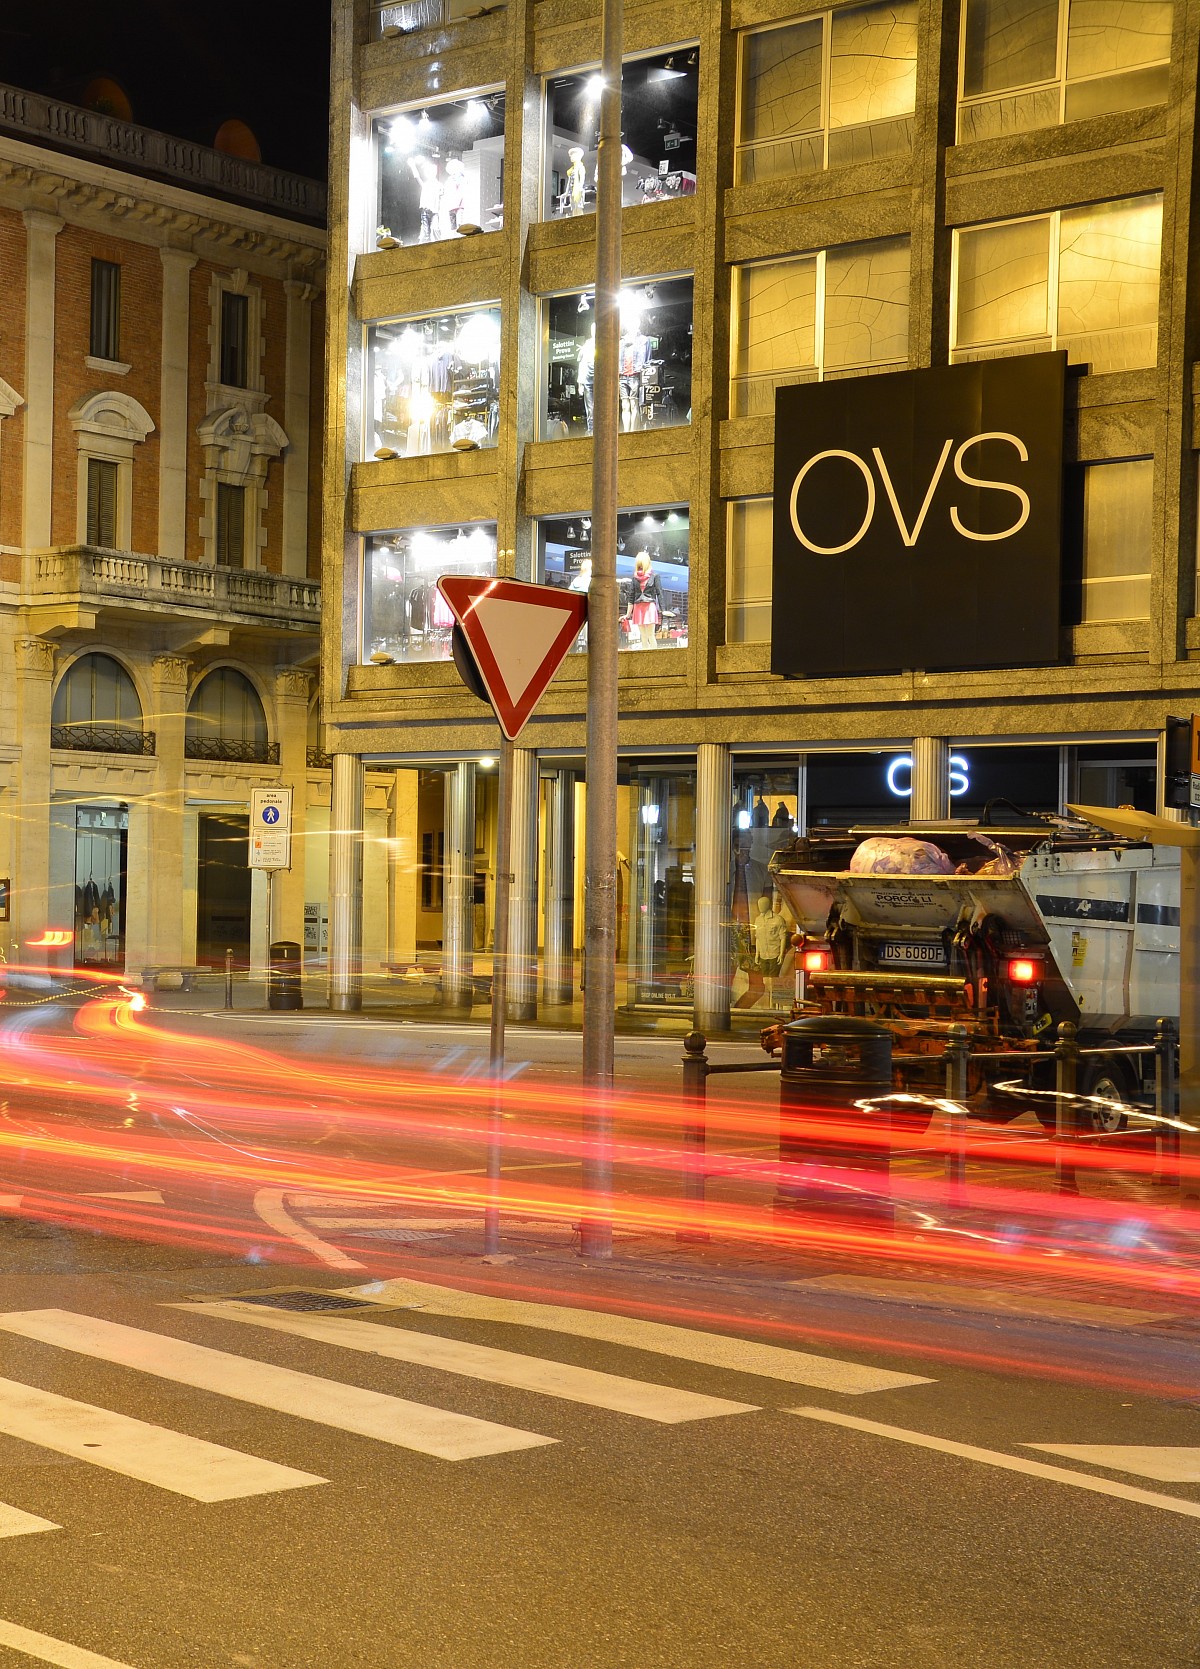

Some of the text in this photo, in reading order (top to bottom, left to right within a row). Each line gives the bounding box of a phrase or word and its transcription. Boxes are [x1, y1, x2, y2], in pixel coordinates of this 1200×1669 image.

[645, 385, 661, 394] 72D
[790, 432, 1030, 555] OVS
[887, 945, 943, 960] DS 608DF
